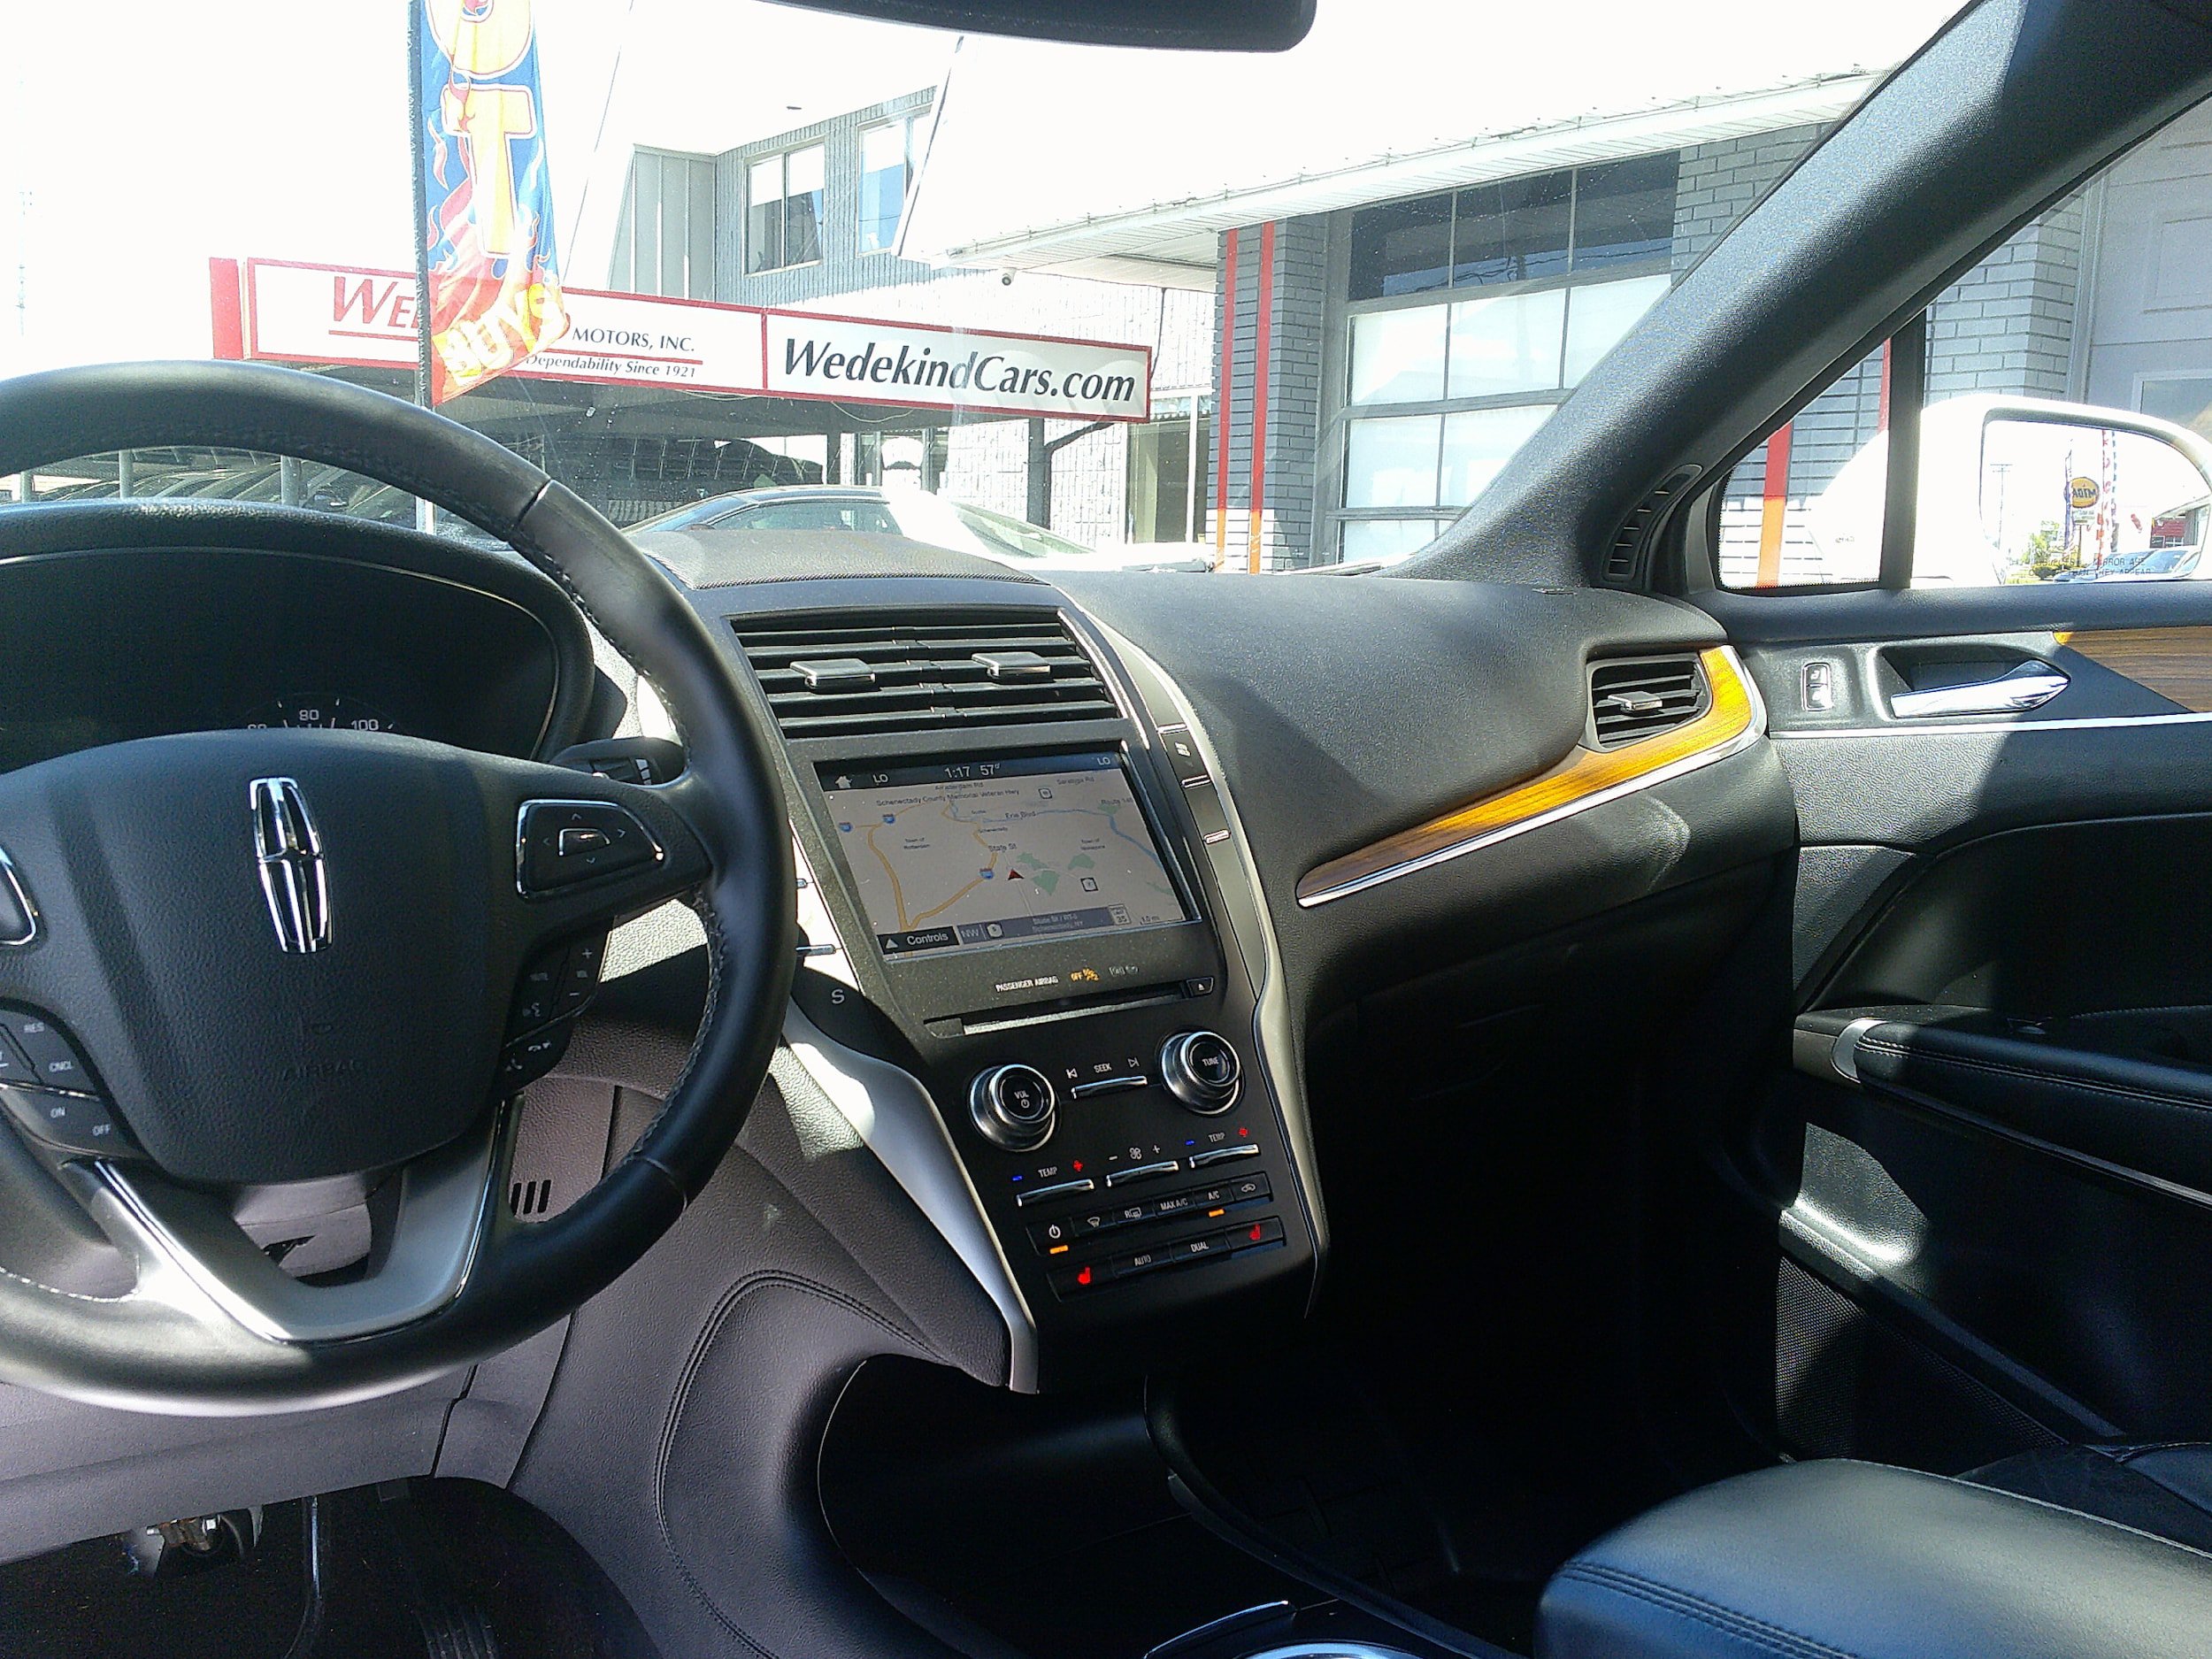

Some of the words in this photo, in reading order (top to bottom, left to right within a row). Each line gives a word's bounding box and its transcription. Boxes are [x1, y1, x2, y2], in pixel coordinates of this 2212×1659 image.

[572, 327, 653, 349] MOTORS,
[660, 335, 695, 351] INC.
[626, 361, 659, 375] Since
[665, 365, 695, 378] 1921
[785, 338, 1135, 402] WedekindCars.com
[299, 710, 319, 720] 80
[351, 719, 379, 731] 100
[1096, 757, 1110, 765] LO
[872, 773, 888, 783] LO
[944, 766, 971, 779] 1:17
[906, 932, 949, 946] Controls
[961, 929, 979, 938] NW
[995, 979, 1033, 992] PASSENGER
[1034, 975, 1059, 986] AIRBAG
[831, 988, 845, 1004] S
[1202, 1056, 1219, 1066] TUNE
[1094, 1062, 1112, 1073] SEEK
[1014, 1090, 1029, 1099] VOL
[50, 1107, 65, 1118] ON
[92, 1124, 111, 1136] OFF
[1208, 1132, 1225, 1142] TEMP
[1038, 1166, 1057, 1178] TEMP
[1208, 1190, 1220, 1201] A/C
[1160, 1200, 1175, 1211] MAX
[1175, 1197, 1188, 1208] A/C
[1190, 1240, 1210, 1252] DUAL
[1134, 1254, 1151, 1266] AUTO
